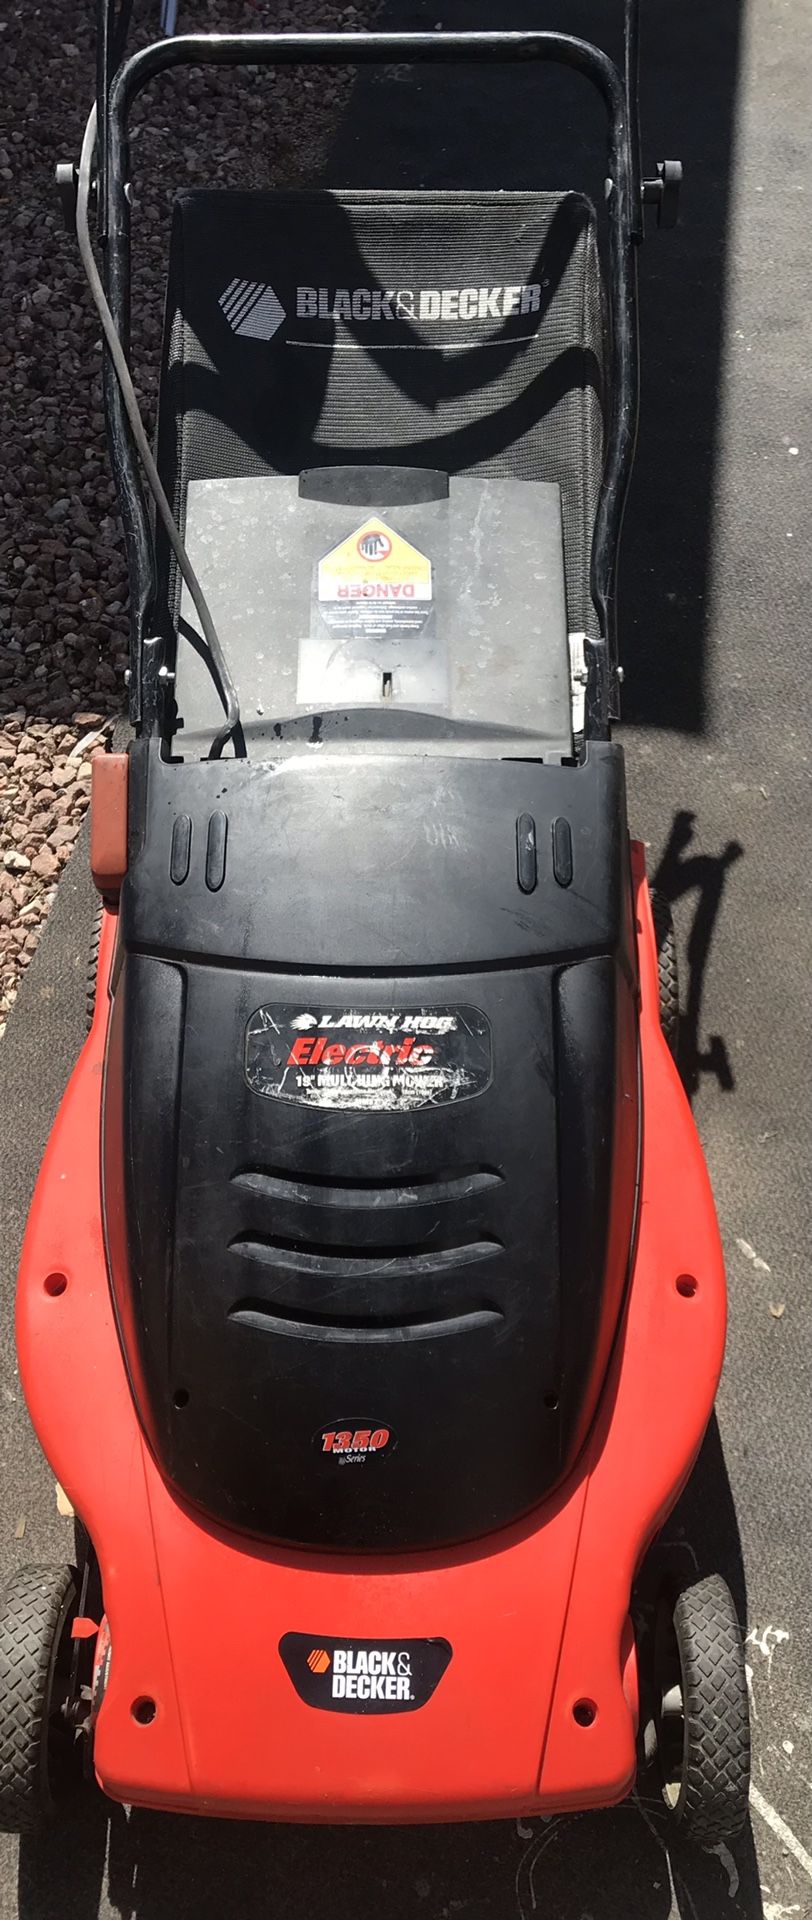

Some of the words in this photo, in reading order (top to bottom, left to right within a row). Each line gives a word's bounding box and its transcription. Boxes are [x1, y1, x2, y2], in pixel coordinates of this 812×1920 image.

[337, 583, 415, 598] DANGER
[317, 1015, 398, 1029] LAWN
[400, 1015, 456, 1030] HOG
[286, 1036, 434, 1066] Electric
[322, 1429, 390, 1451] 1350
[345, 1454, 366, 1463] Series
